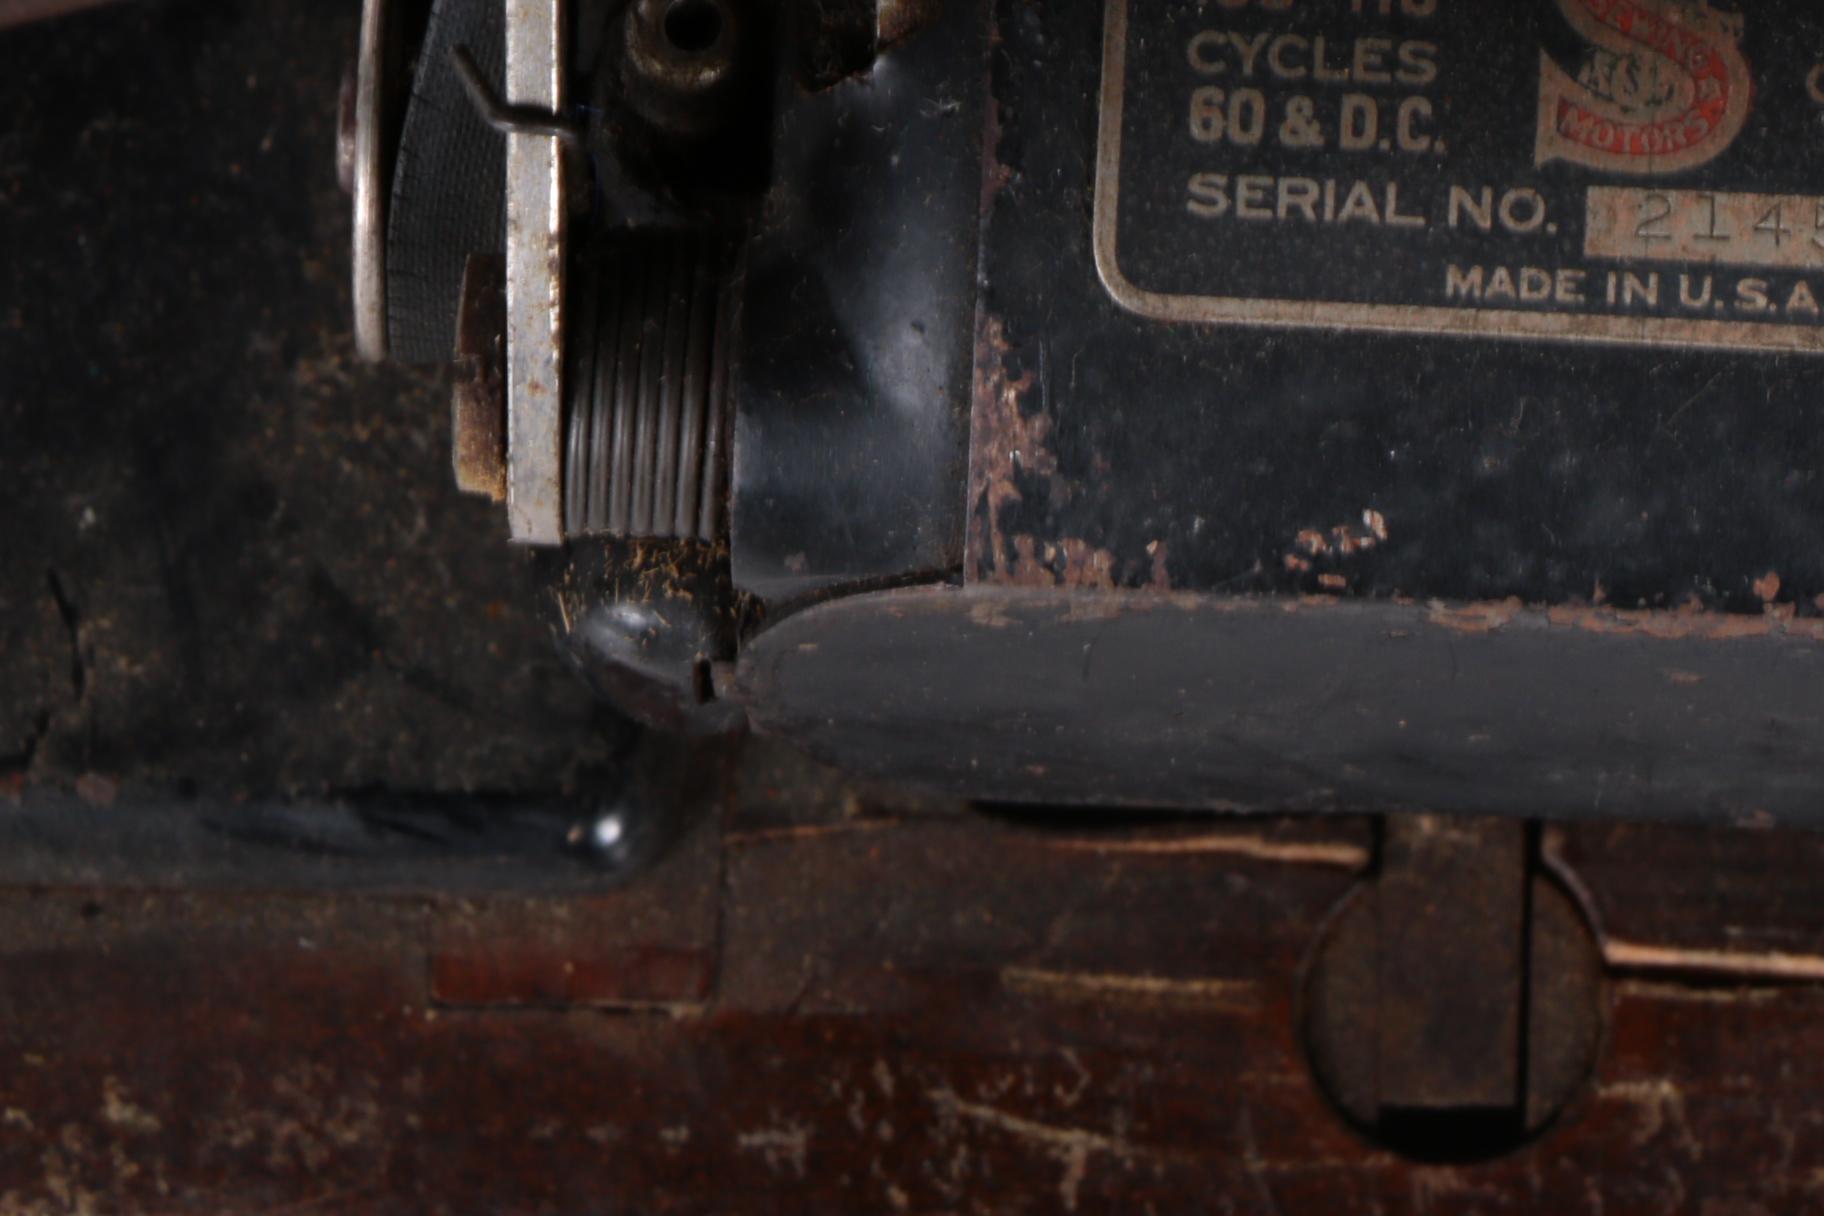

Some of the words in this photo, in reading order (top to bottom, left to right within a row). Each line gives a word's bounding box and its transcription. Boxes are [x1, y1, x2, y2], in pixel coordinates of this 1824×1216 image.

[1186, 29, 1438, 84] CYCLES
[1189, 86, 1265, 146] 60
[1279, 95, 1325, 147] &
[1339, 92, 1449, 152] D.C.
[1560, 107, 1709, 155] MOTORS
[1186, 171, 1426, 225] SERIAL
[1448, 185, 1558, 234] NO.
[1445, 264, 1585, 303] MADE
[1607, 271, 1658, 306] IN
